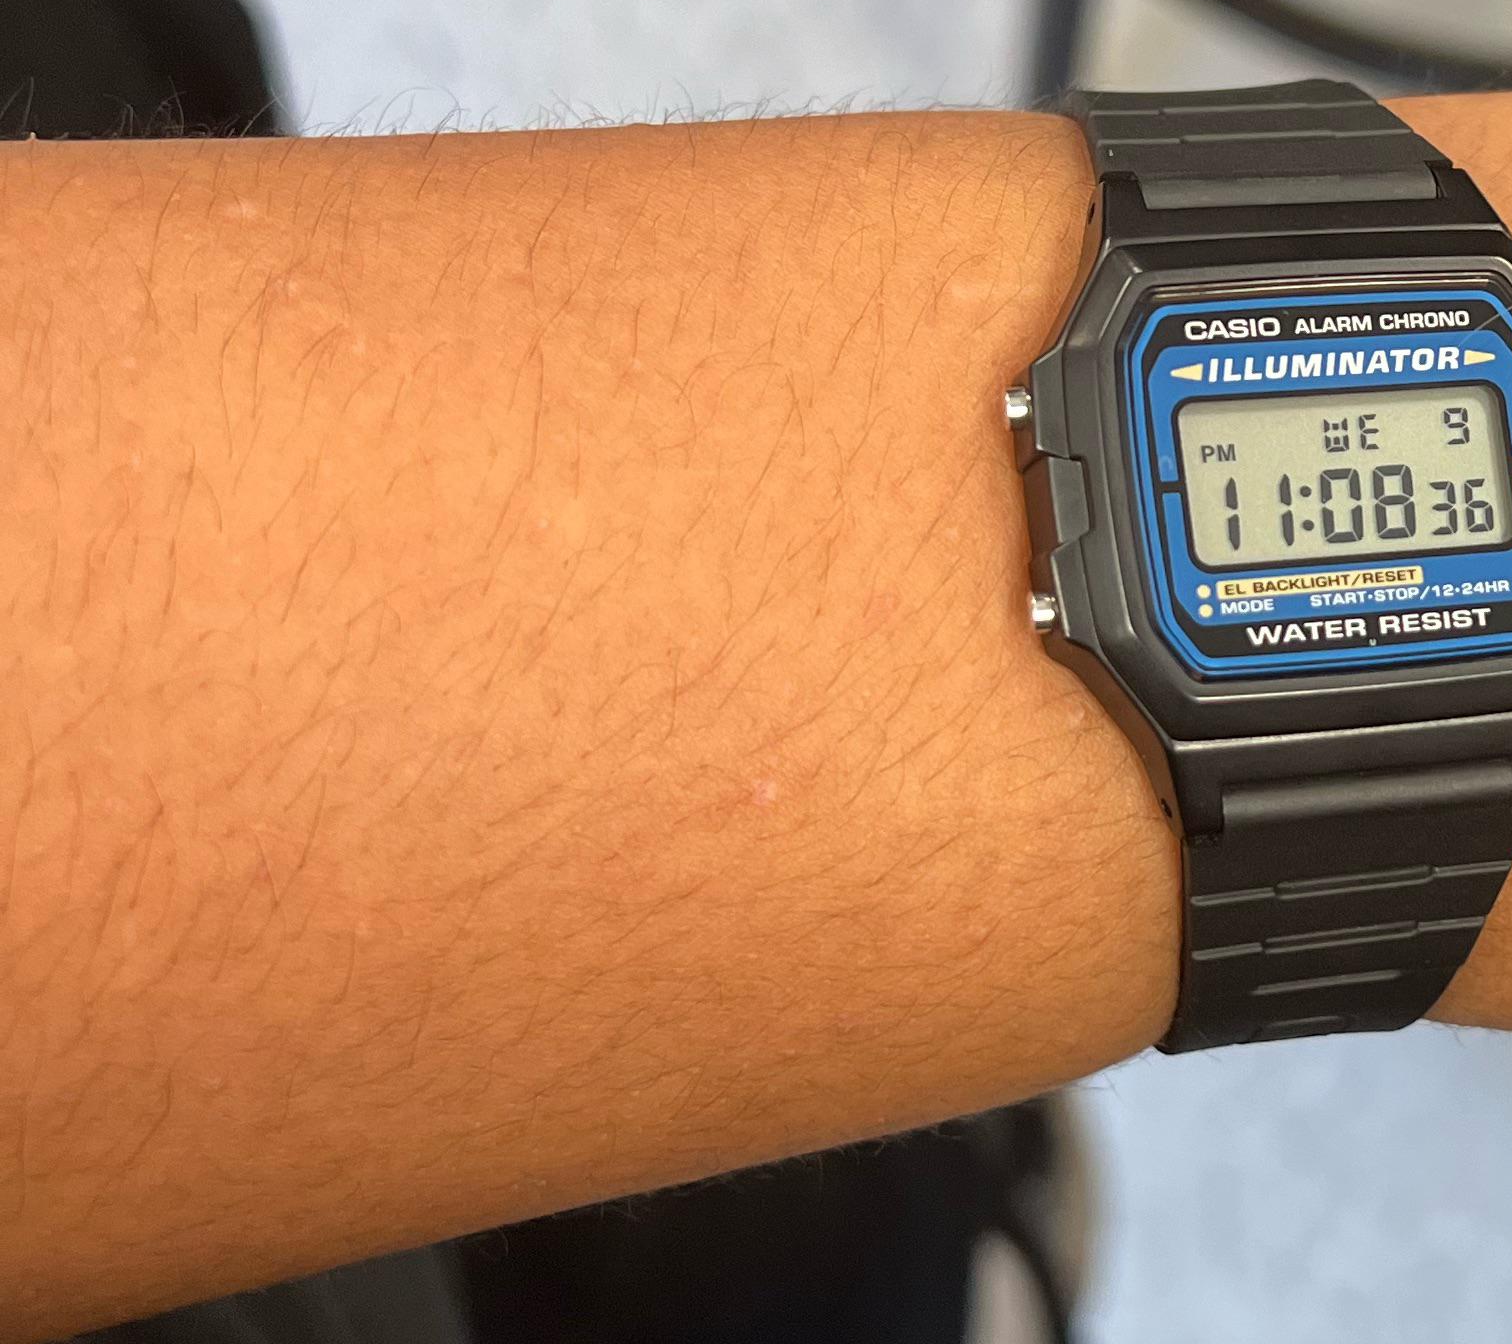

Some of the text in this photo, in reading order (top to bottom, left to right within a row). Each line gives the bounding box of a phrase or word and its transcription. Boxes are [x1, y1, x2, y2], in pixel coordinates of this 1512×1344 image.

[1184, 310, 1470, 340] CASIO ALARM CHRONO
[1208, 346, 1460, 384] ILLUMINATOR
[1442, 407, 1471, 446] 9
[1200, 443, 1236, 464] PM
[1428, 478, 1494, 536] 36
[1224, 568, 1418, 596] EL BACKLIGHT/RESET
[1220, 599, 1275, 615] MODE
[1246, 607, 1491, 647] WATER RESIST
